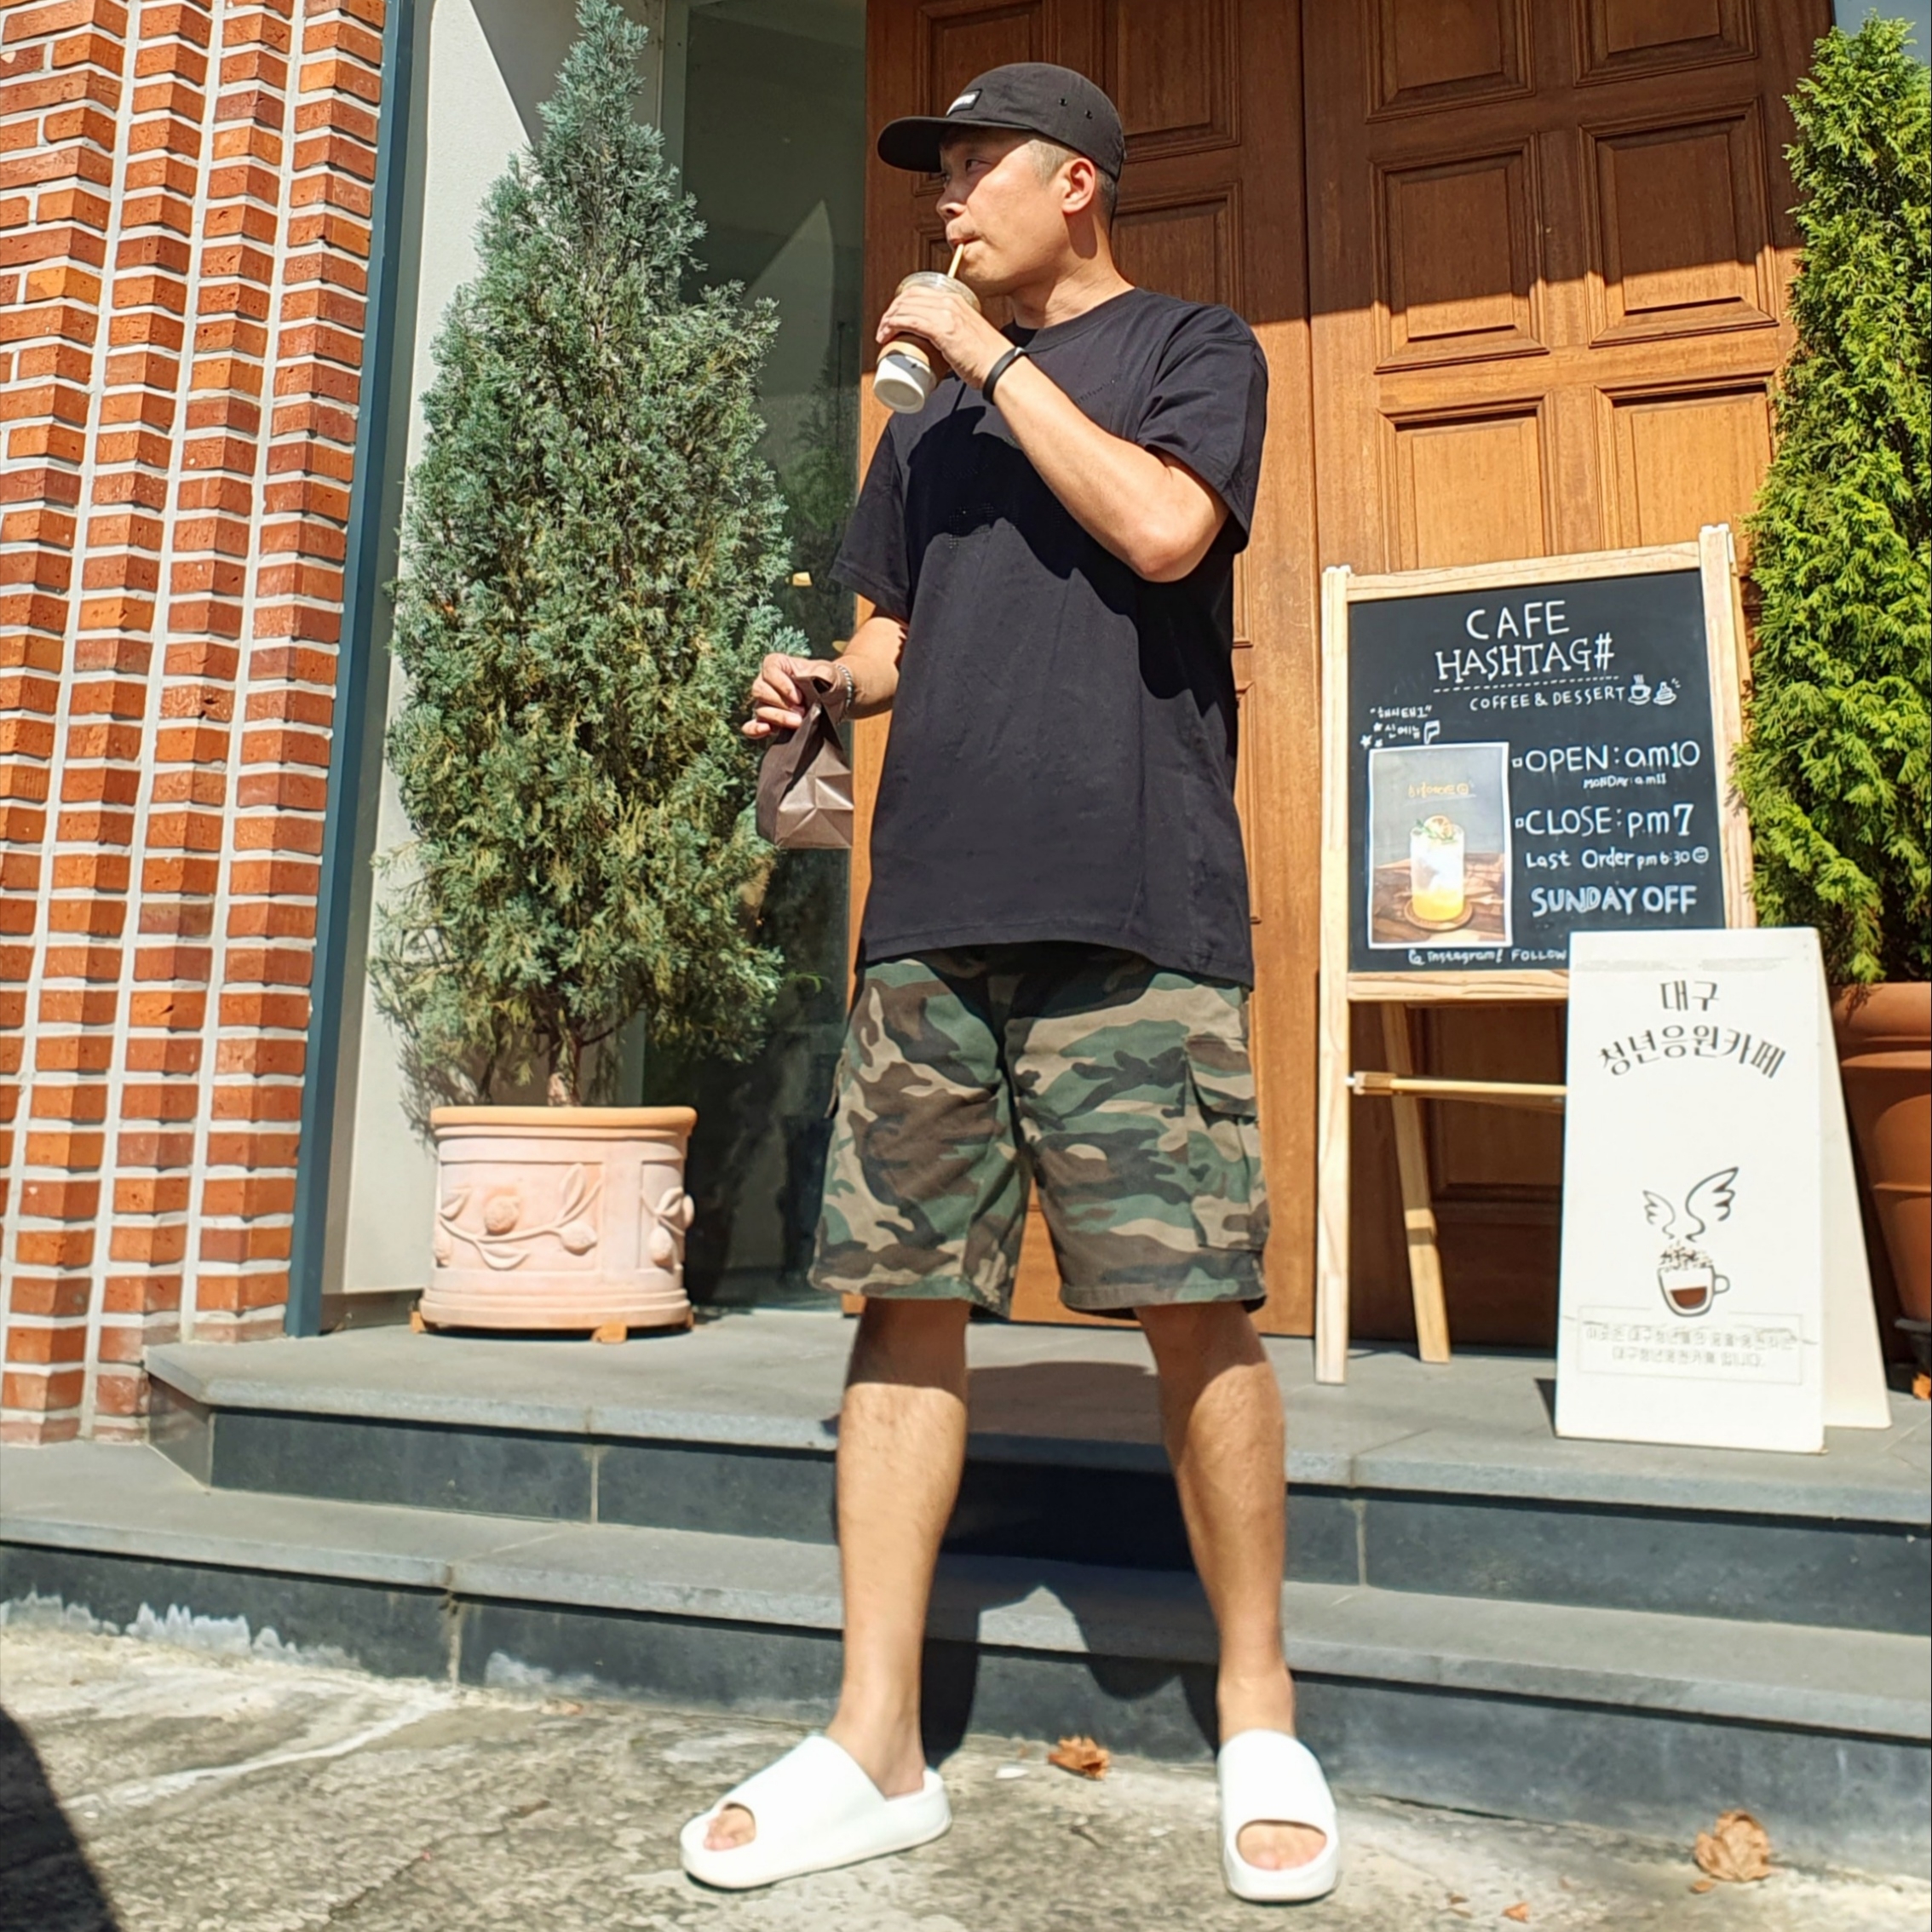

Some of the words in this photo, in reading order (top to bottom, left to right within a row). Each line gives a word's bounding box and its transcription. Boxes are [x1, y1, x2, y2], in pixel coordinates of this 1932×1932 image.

[1466, 600, 1570, 640] CAFE
[1435, 632, 1615, 683] HASHTAG#
[1469, 694, 1530, 711] COFFEE
[1534, 692, 1548, 707] &
[1553, 686, 1625, 706] DESSERT
[1527, 850, 1572, 870] Last
[1582, 846, 1635, 869] Order
[1531, 886, 1637, 917] SUNDAY
[1642, 885, 1698, 914] OFF
[1660, 980, 1719, 1011] 대구
[1599, 1025, 1786, 1078] 청년응원카페
